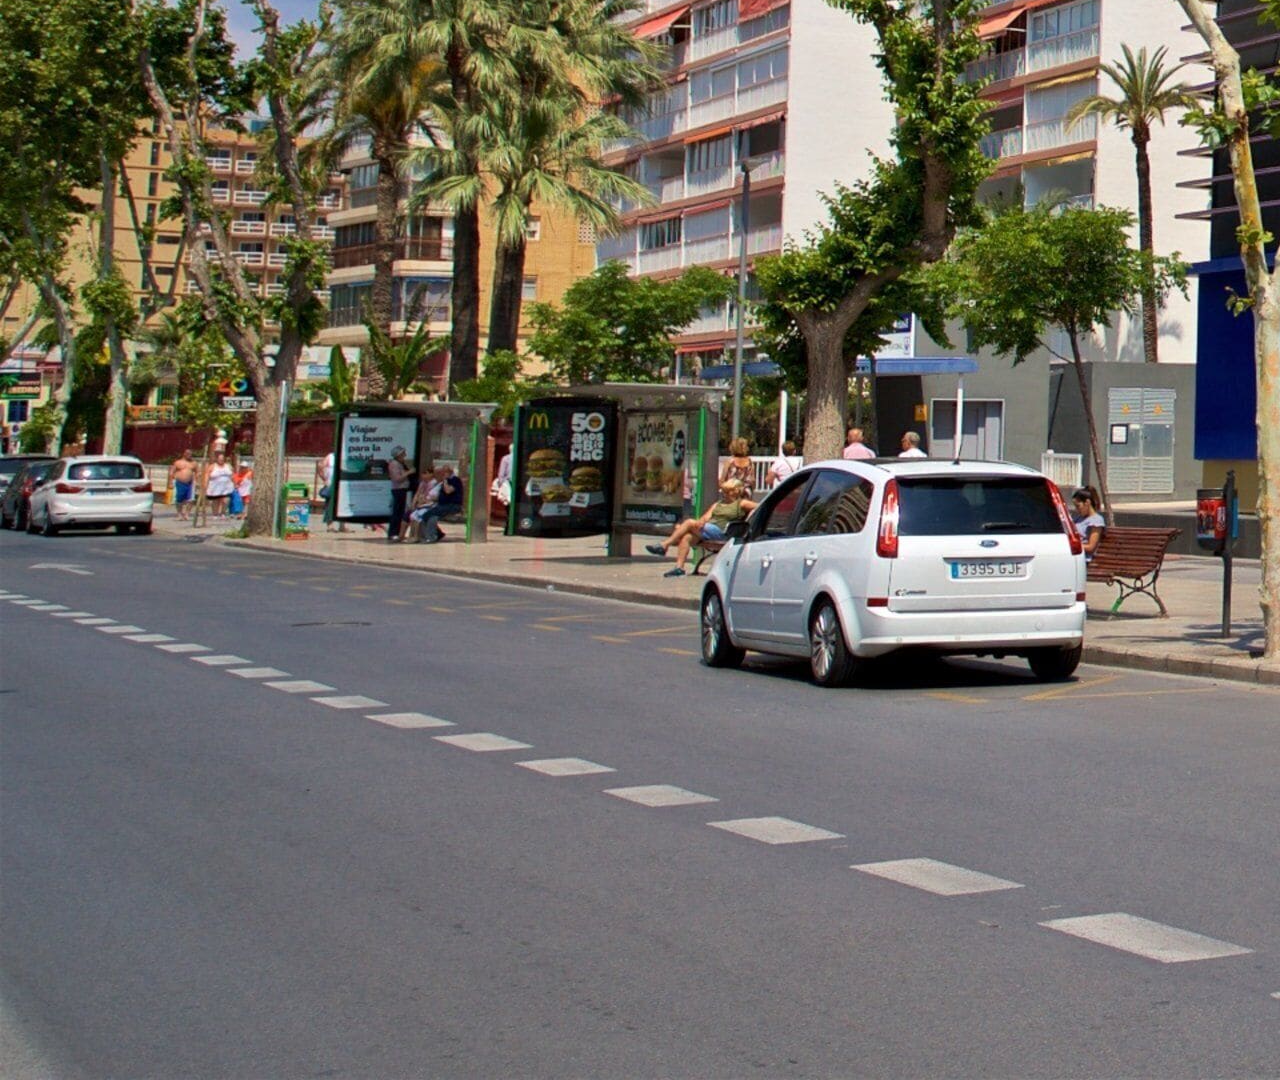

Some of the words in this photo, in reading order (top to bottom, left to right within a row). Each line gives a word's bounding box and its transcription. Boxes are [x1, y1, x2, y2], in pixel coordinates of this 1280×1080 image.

[571, 412, 605, 432] 50
[349, 425, 377, 436] Viajar
[362, 435, 393, 443] bueno
[348, 445, 370, 453] para
[961, 564, 994, 576] 3395
[999, 563, 1022, 574] GJF
